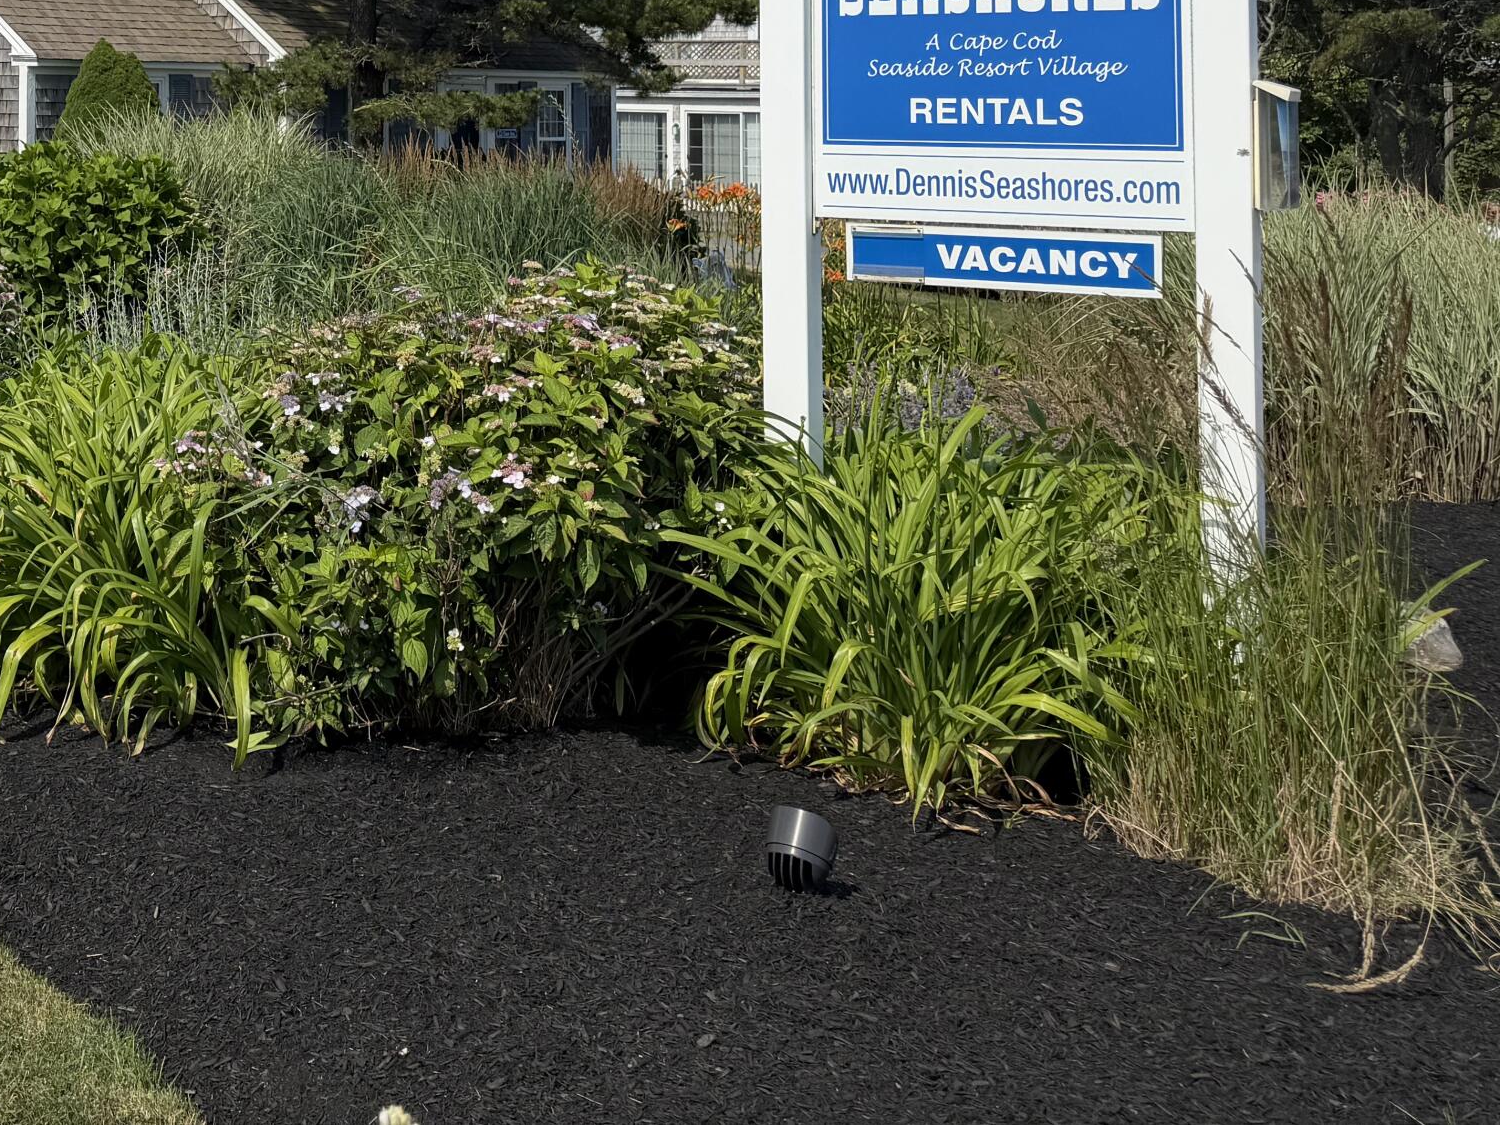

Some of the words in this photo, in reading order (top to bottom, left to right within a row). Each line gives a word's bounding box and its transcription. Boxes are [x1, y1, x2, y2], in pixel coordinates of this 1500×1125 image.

[925, 33, 940, 51] A
[949, 33, 1008, 56] Cape
[1012, 30, 1063, 50] Cod
[867, 57, 954, 77] Seaside
[958, 58, 1033, 77] Resort
[1037, 56, 1128, 82] Village
[909, 97, 1085, 126] RENTALS
[827, 167, 1181, 205] www.DennisSeashores.com
[936, 243, 1138, 279] VACANCY
